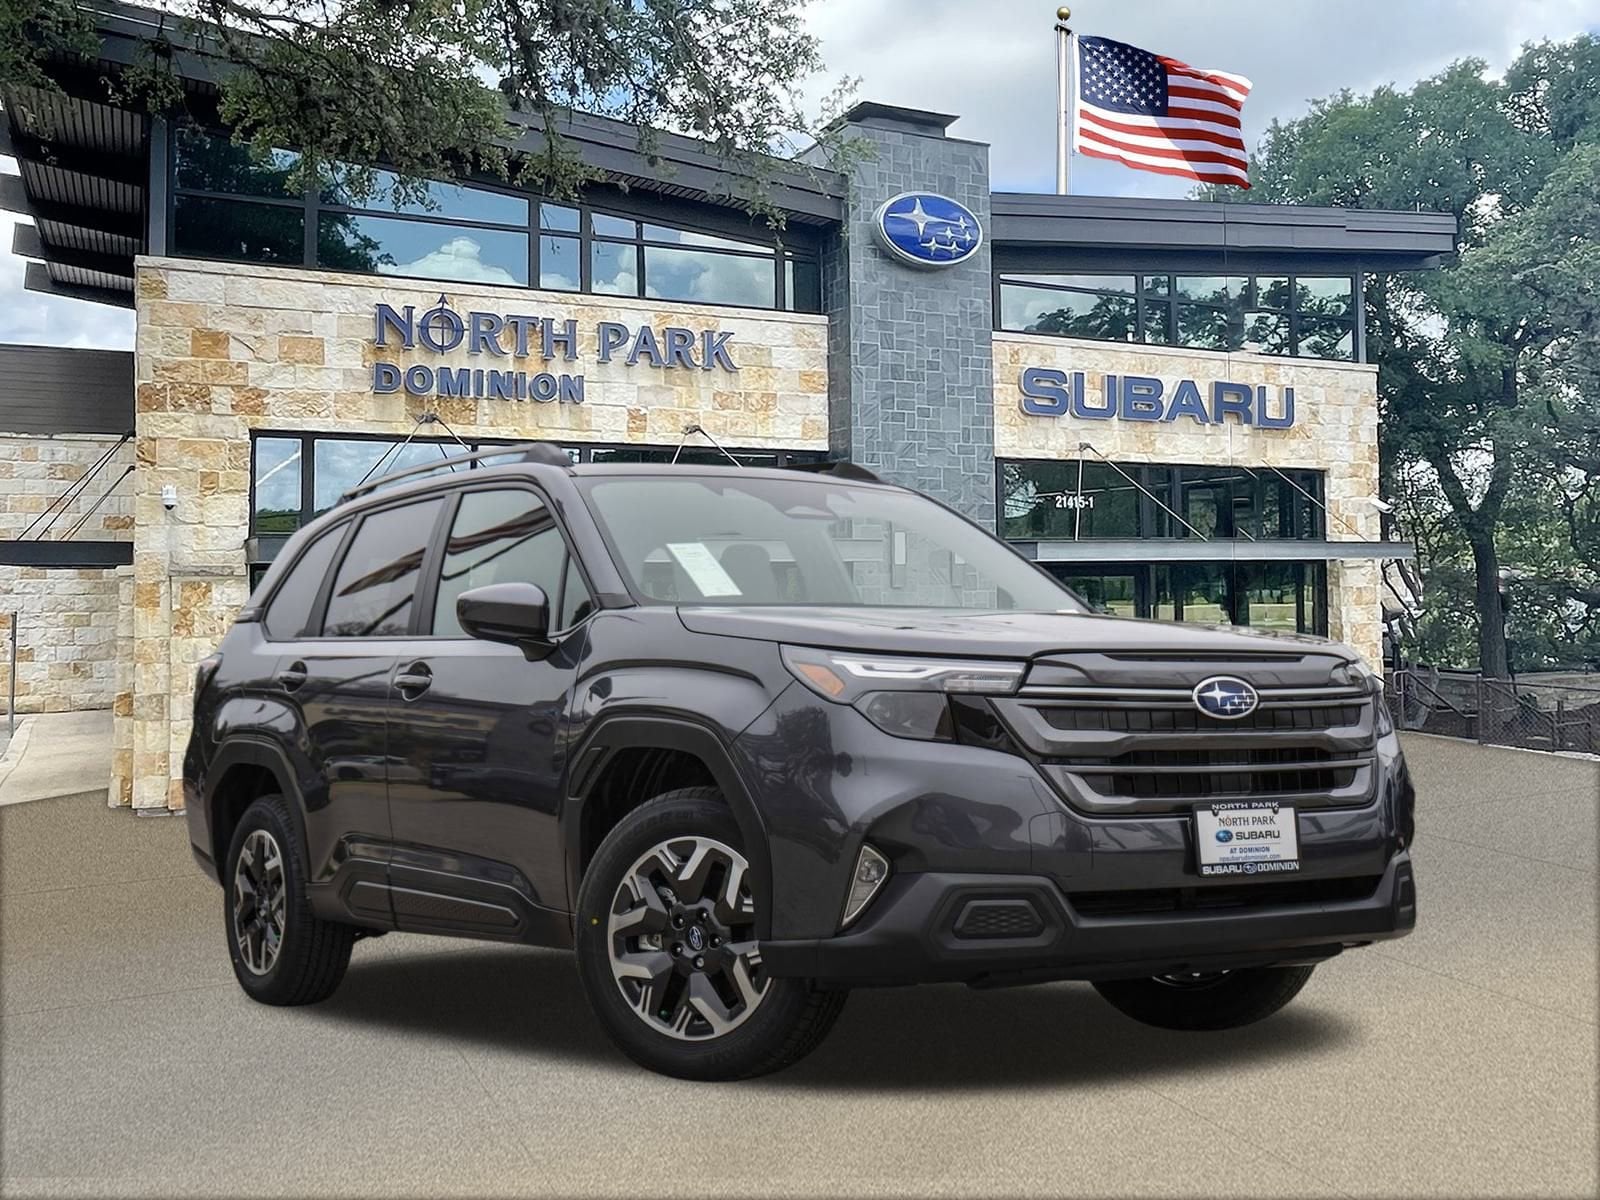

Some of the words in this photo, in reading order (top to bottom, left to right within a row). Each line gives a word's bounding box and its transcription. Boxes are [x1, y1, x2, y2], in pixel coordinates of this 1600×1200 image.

[373, 299, 580, 361] NORTH
[597, 321, 741, 373] PARK
[373, 362, 585, 403] DOMINION
[1018, 366, 1295, 430] SUBARU
[1251, 801, 1280, 809] PARK
[1218, 815, 1250, 827] NORTH
[1251, 815, 1276, 826] PARK
[1235, 830, 1280, 840] SUBARU
[1239, 846, 1271, 854] DOMINION
[1202, 865, 1243, 875] SUBARU
[1257, 861, 1300, 872] DOMINION
